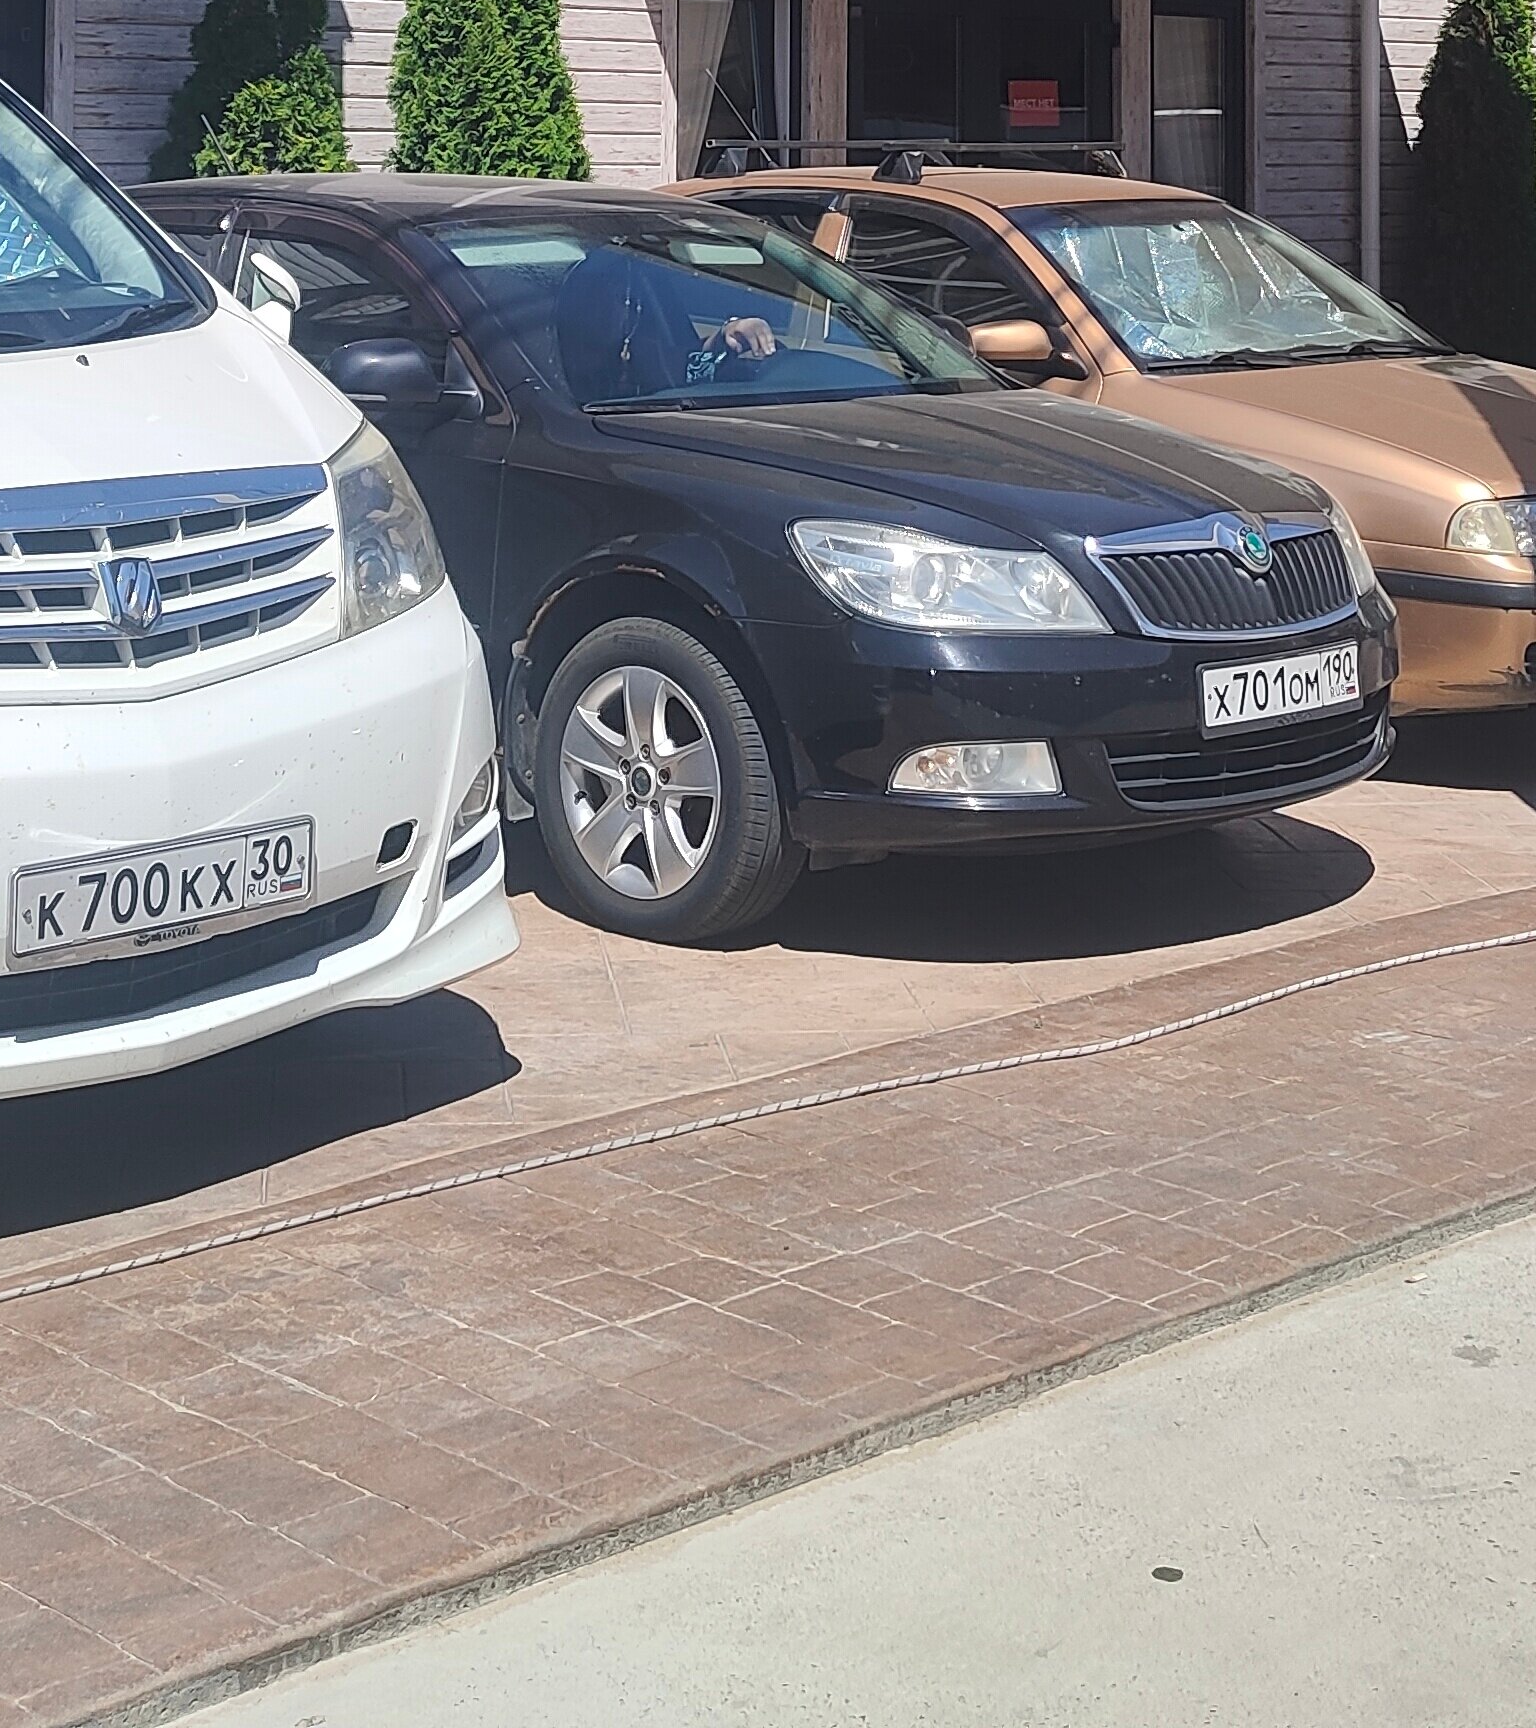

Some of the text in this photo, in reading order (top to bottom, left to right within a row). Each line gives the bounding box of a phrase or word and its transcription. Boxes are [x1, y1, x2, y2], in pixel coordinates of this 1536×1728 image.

[1323, 651, 1352, 686] 190
[1330, 684, 1346, 698] RUS
[250, 835, 293, 880] 30
[246, 878, 278, 899] RUS
[158, 923, 201, 940] TOYOTA
